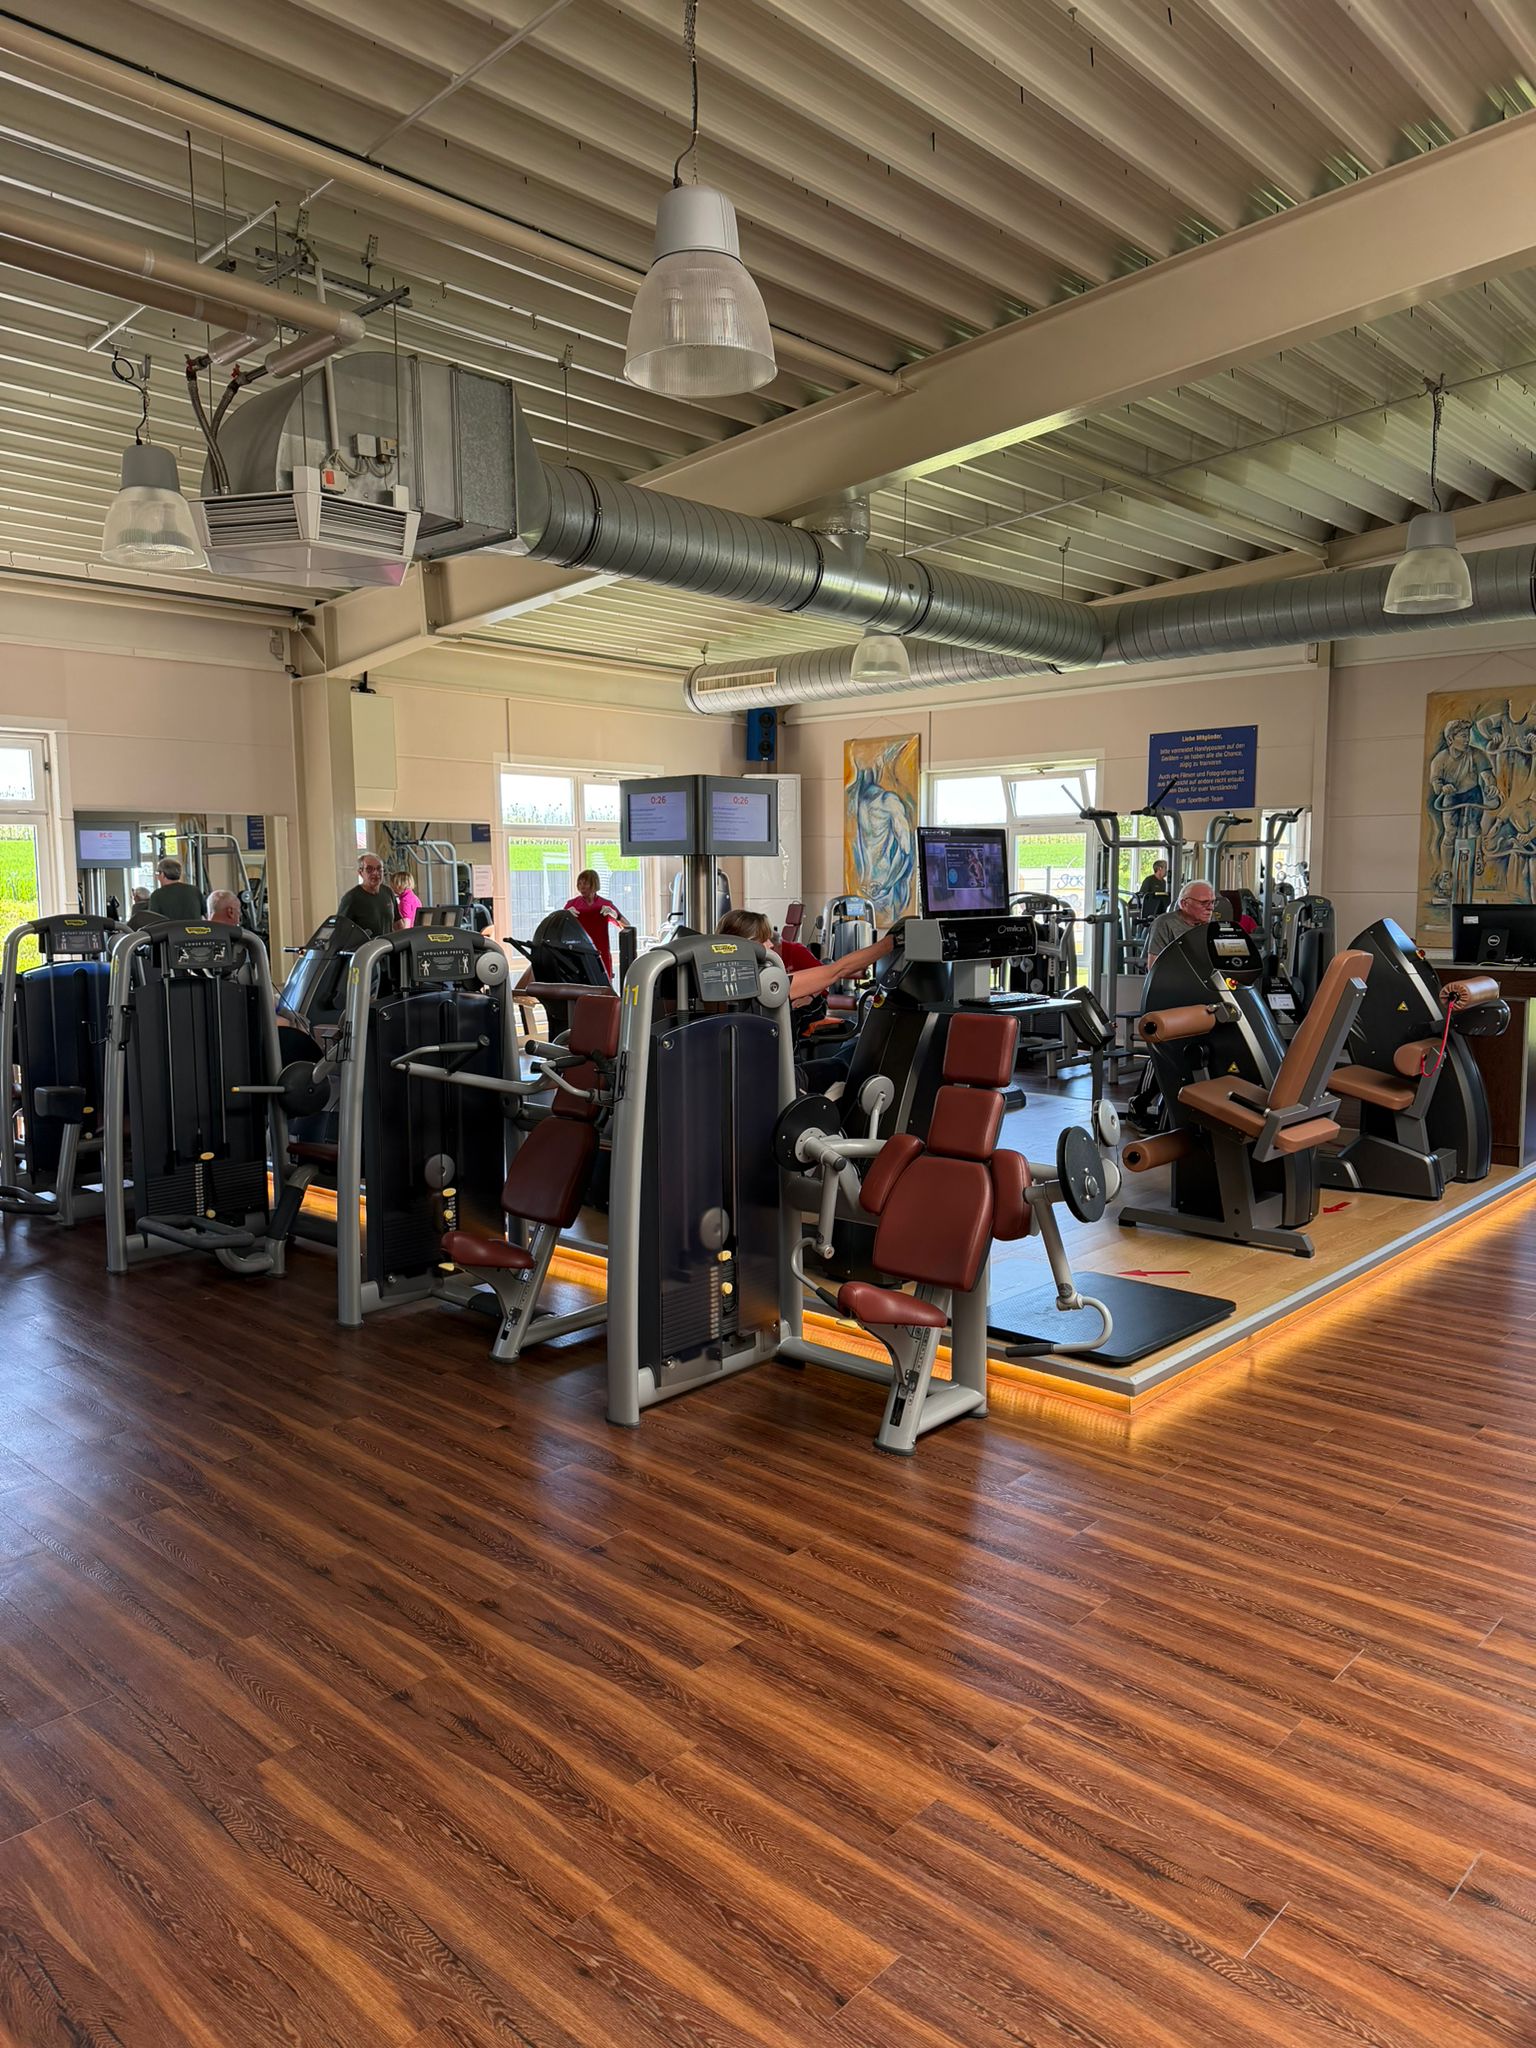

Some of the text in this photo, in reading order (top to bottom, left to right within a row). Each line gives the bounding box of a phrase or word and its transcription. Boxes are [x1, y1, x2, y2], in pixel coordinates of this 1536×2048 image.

[651, 796, 666, 804] 0:26
[733, 796, 748, 804] 0:26
[624, 984, 639, 1006] 11
